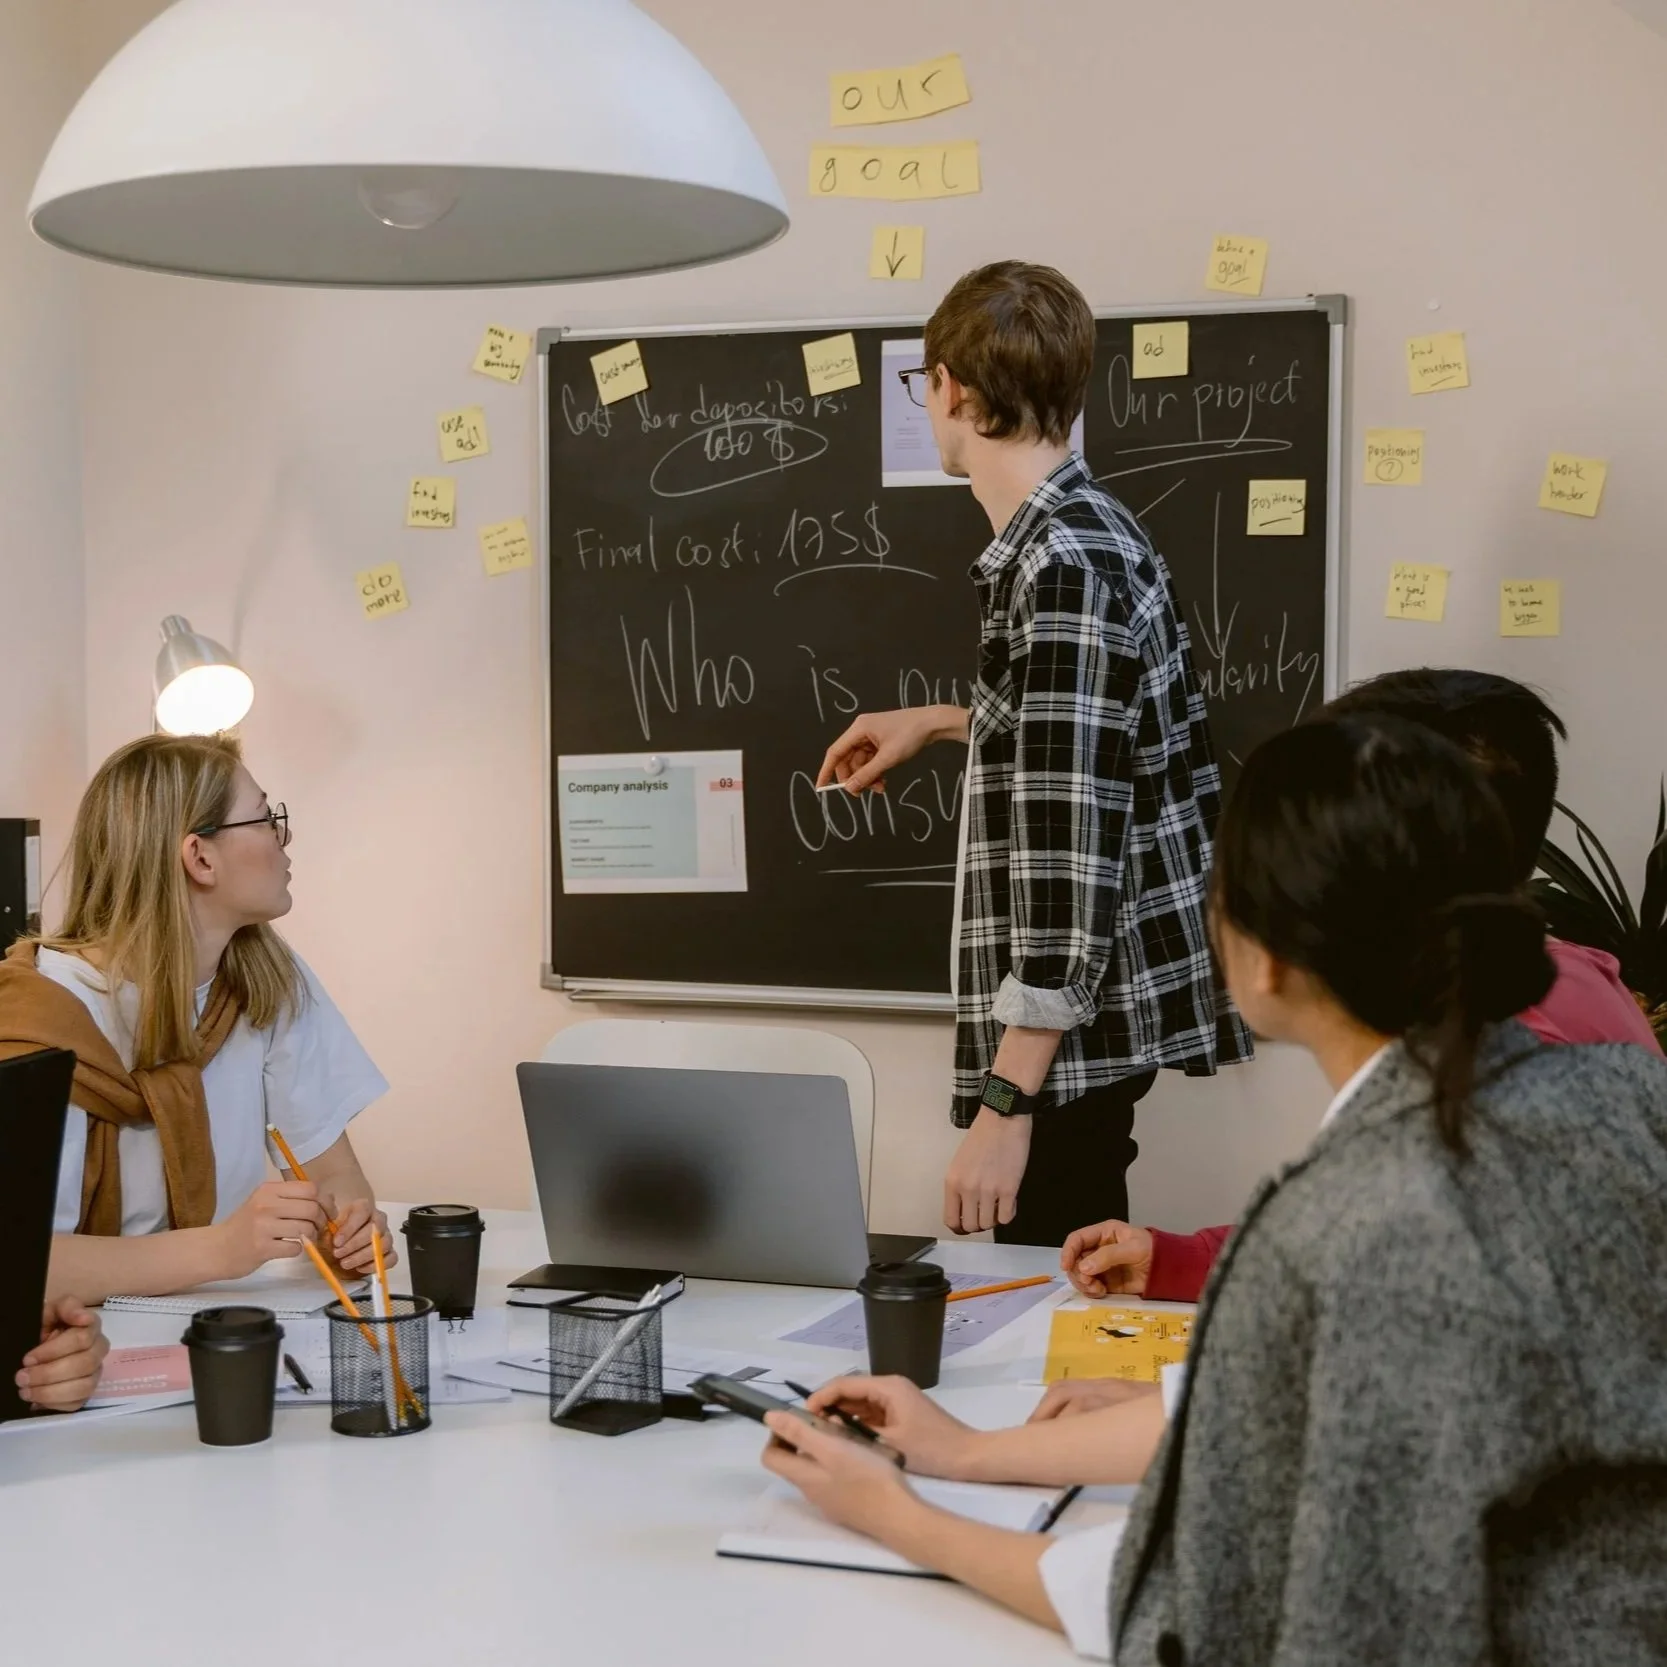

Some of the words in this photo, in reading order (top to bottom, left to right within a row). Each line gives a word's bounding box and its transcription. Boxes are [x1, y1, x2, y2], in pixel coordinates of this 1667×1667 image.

[841, 68, 943, 112] our
[818, 150, 959, 193] goal
[1192, 354, 1303, 449] project
[573, 515, 659, 573] Final
[361, 572, 393, 596] do
[619, 585, 755, 741] Who
[797, 644, 860, 723] is
[568, 782, 620, 795] Company
[622, 780, 669, 793] analysis
[719, 778, 734, 789] 03
